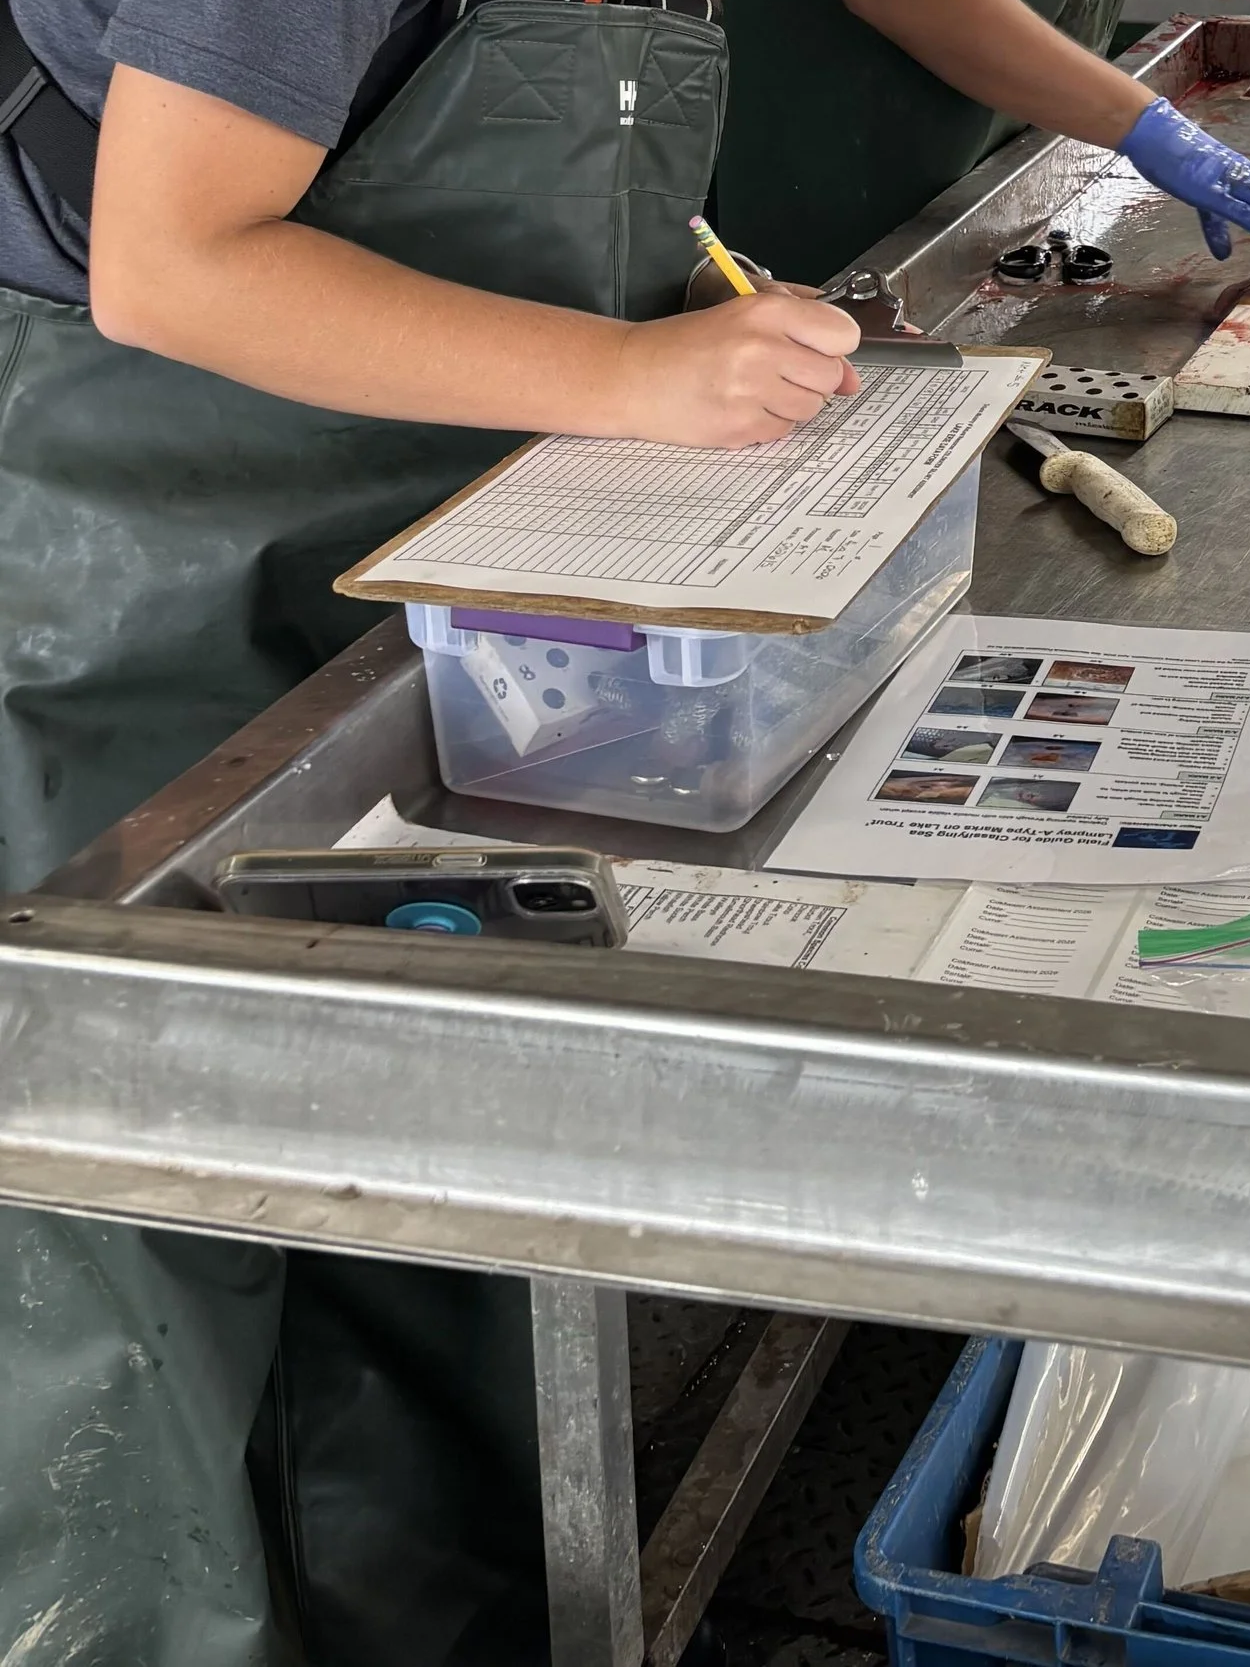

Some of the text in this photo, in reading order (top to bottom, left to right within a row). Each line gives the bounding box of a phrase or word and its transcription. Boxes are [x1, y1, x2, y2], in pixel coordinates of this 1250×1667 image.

[1014, 399, 1104, 420] RACK
[905, 821, 942, 830] Lake
[960, 824, 1004, 833] Marks
[905, 829, 935, 837] Sea
[933, 829, 1012, 841] Classifying
[1003, 825, 1055, 836] A-Type
[1053, 828, 1115, 838] Lamprey
[1032, 835, 1075, 844] Guide
[1075, 838, 1111, 846] Field
